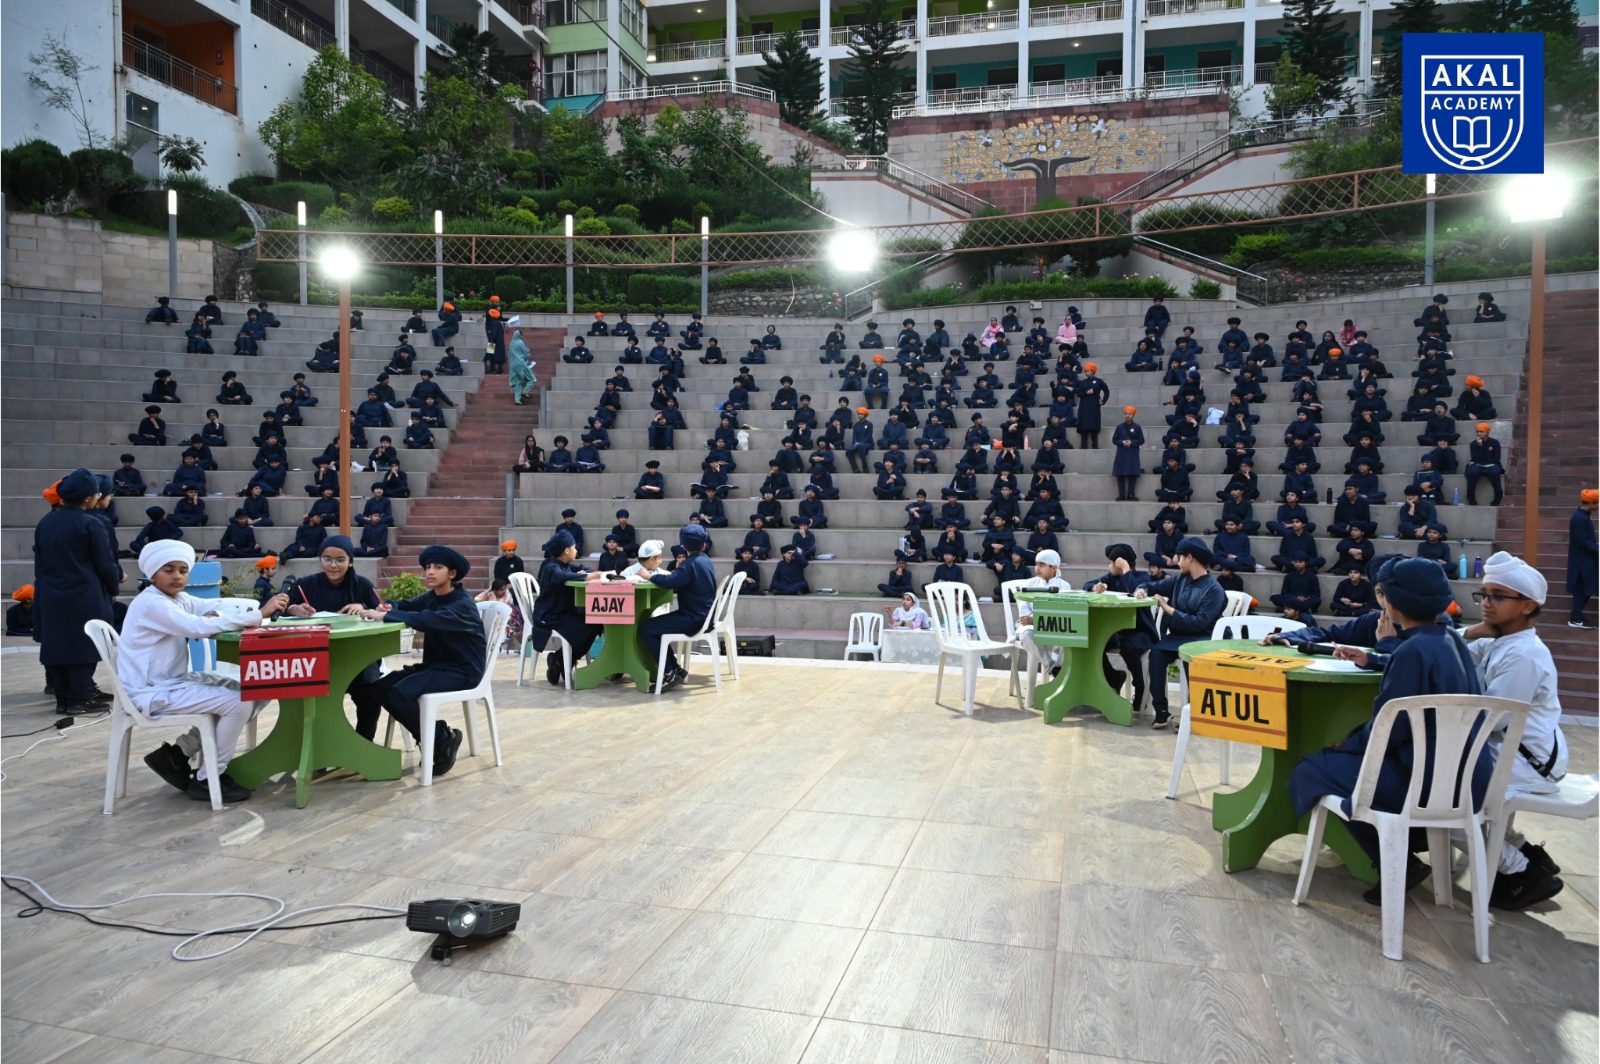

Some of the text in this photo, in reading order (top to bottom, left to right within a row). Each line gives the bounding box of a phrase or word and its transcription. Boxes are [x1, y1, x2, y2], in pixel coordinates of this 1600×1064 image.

[591, 597, 625, 613] AJAY
[1037, 615, 1077, 633] AMUL
[244, 657, 317, 682] ABHAY
[1200, 688, 1270, 725] ATUL
